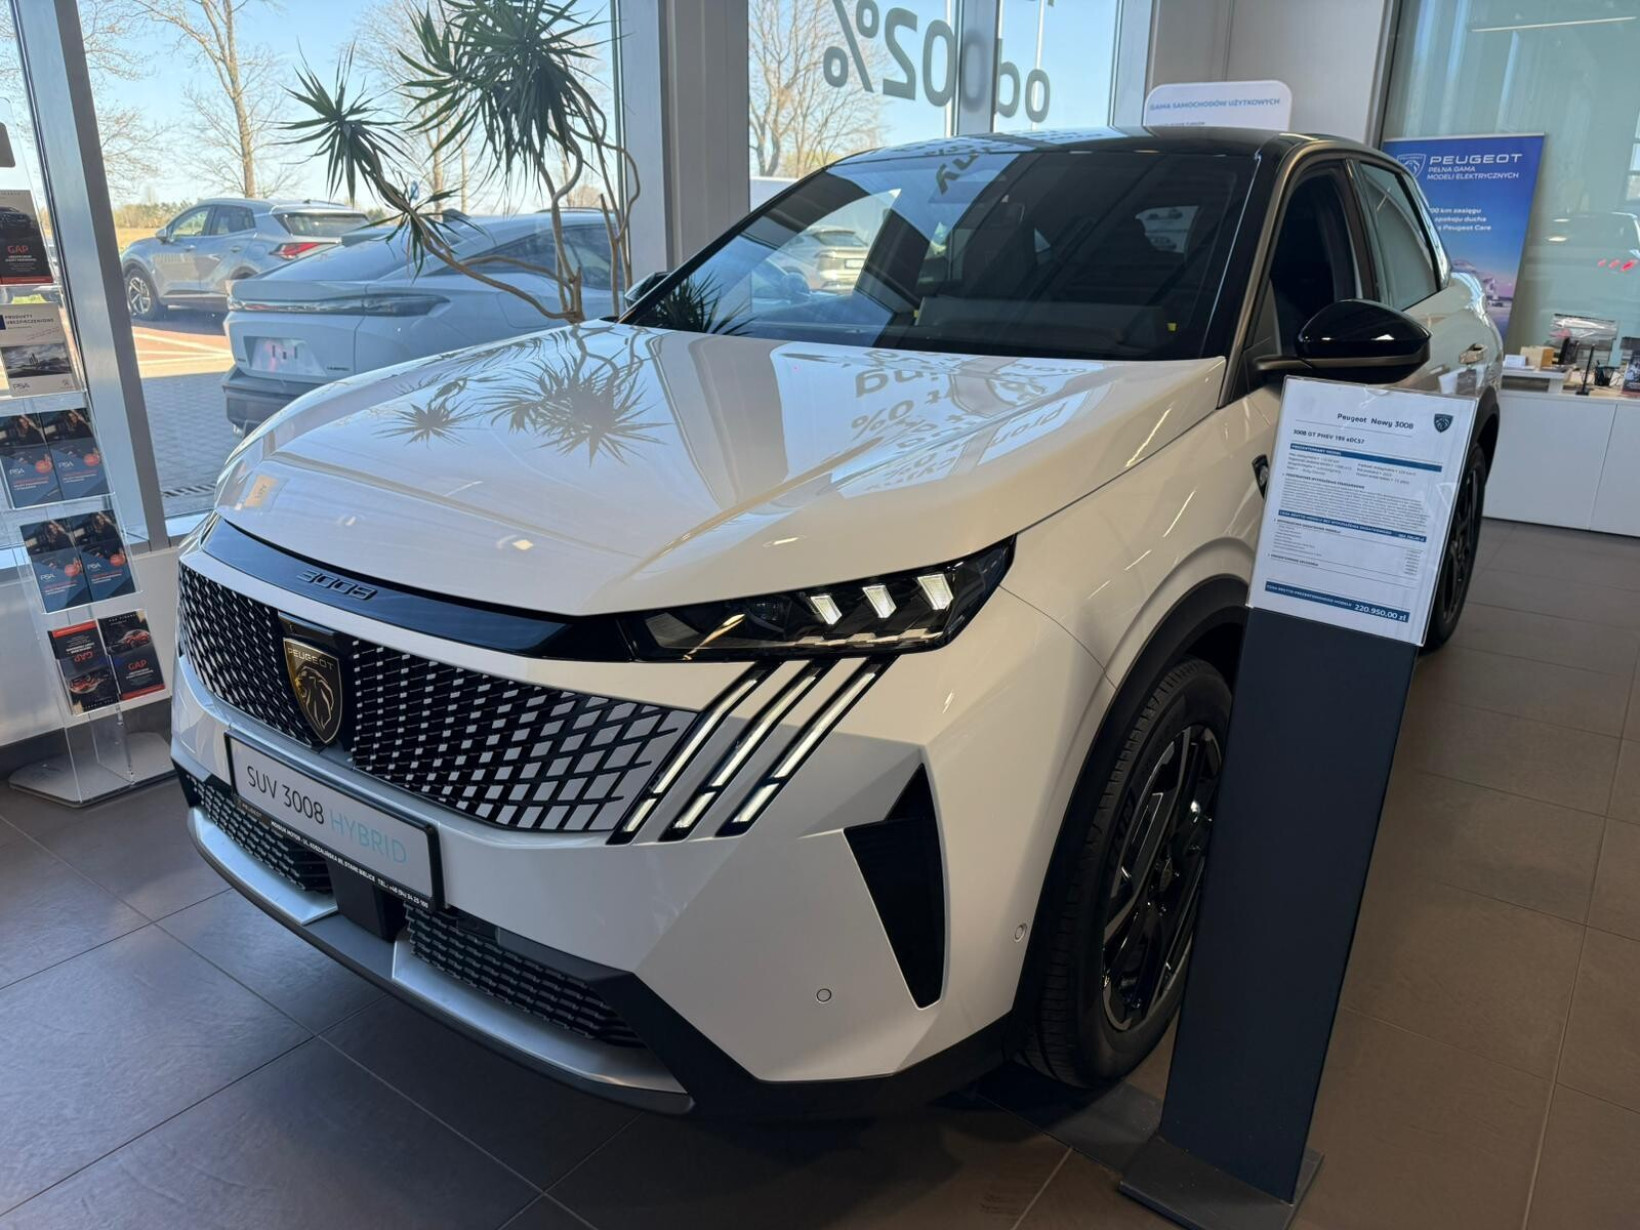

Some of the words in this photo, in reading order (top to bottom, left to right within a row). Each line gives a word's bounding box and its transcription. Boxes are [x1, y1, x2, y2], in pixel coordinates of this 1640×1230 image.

[1429, 153, 1523, 165] PEUGEOT
[1426, 173, 1455, 181] MODELI
[1456, 172, 1519, 180] ELEKTRYCZNYCH
[1337, 412, 1367, 424] Peugeot
[1371, 418, 1393, 428] Nowy
[1395, 420, 1414, 430] 3008
[297, 569, 378, 601] 3008
[288, 647, 335, 670] PEUGEOT
[247, 766, 277, 799] SUV
[282, 784, 325, 825] 3008
[329, 810, 408, 863] HYBRID
